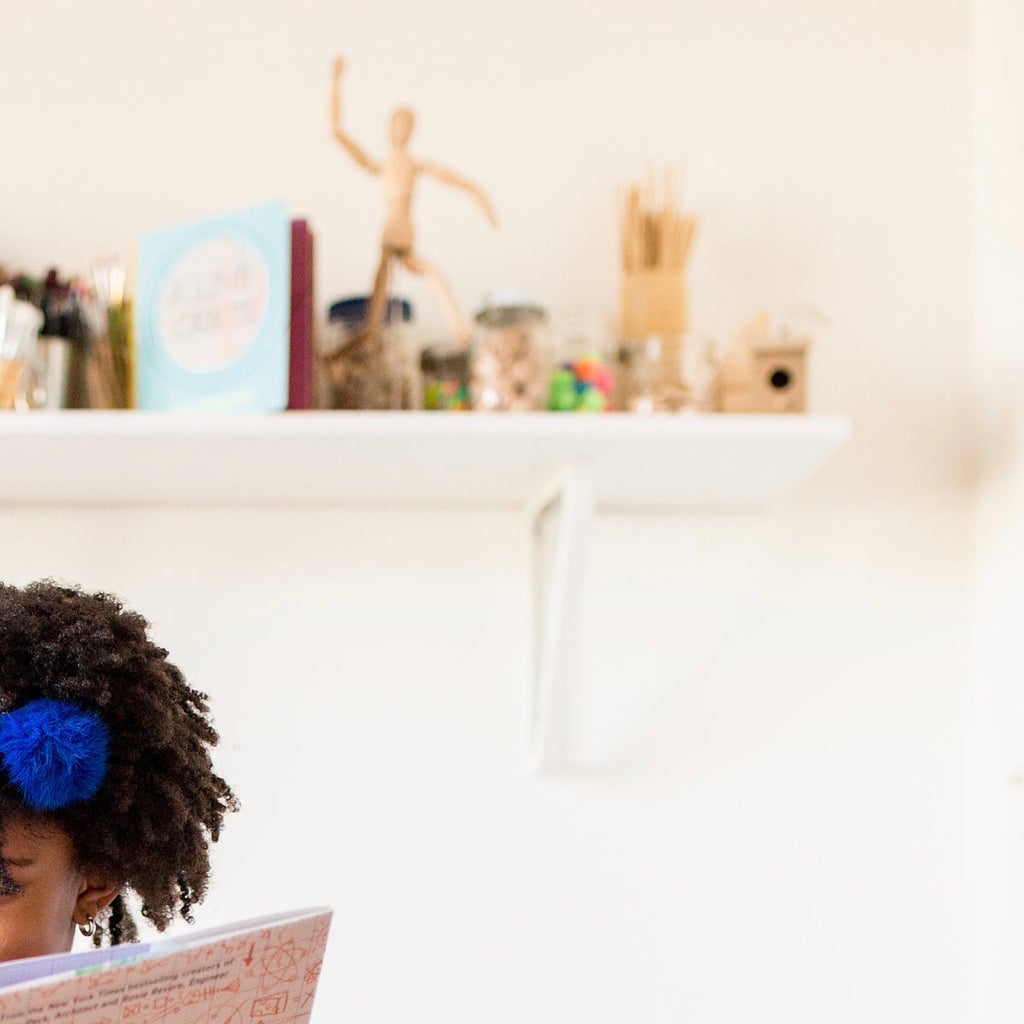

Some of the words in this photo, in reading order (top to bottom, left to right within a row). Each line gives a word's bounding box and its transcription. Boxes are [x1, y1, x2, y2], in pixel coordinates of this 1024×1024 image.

[0, 1010, 25, 1022] From
[48, 999, 68, 1010] New
[72, 992, 93, 1004] York
[98, 985, 125, 997] Times
[127, 972, 179, 991] bestselling
[180, 961, 220, 977] creators
[55, 1002, 98, 1019] Architect
[121, 990, 148, 1003] Rosie
[187, 970, 229, 987] Engineer
